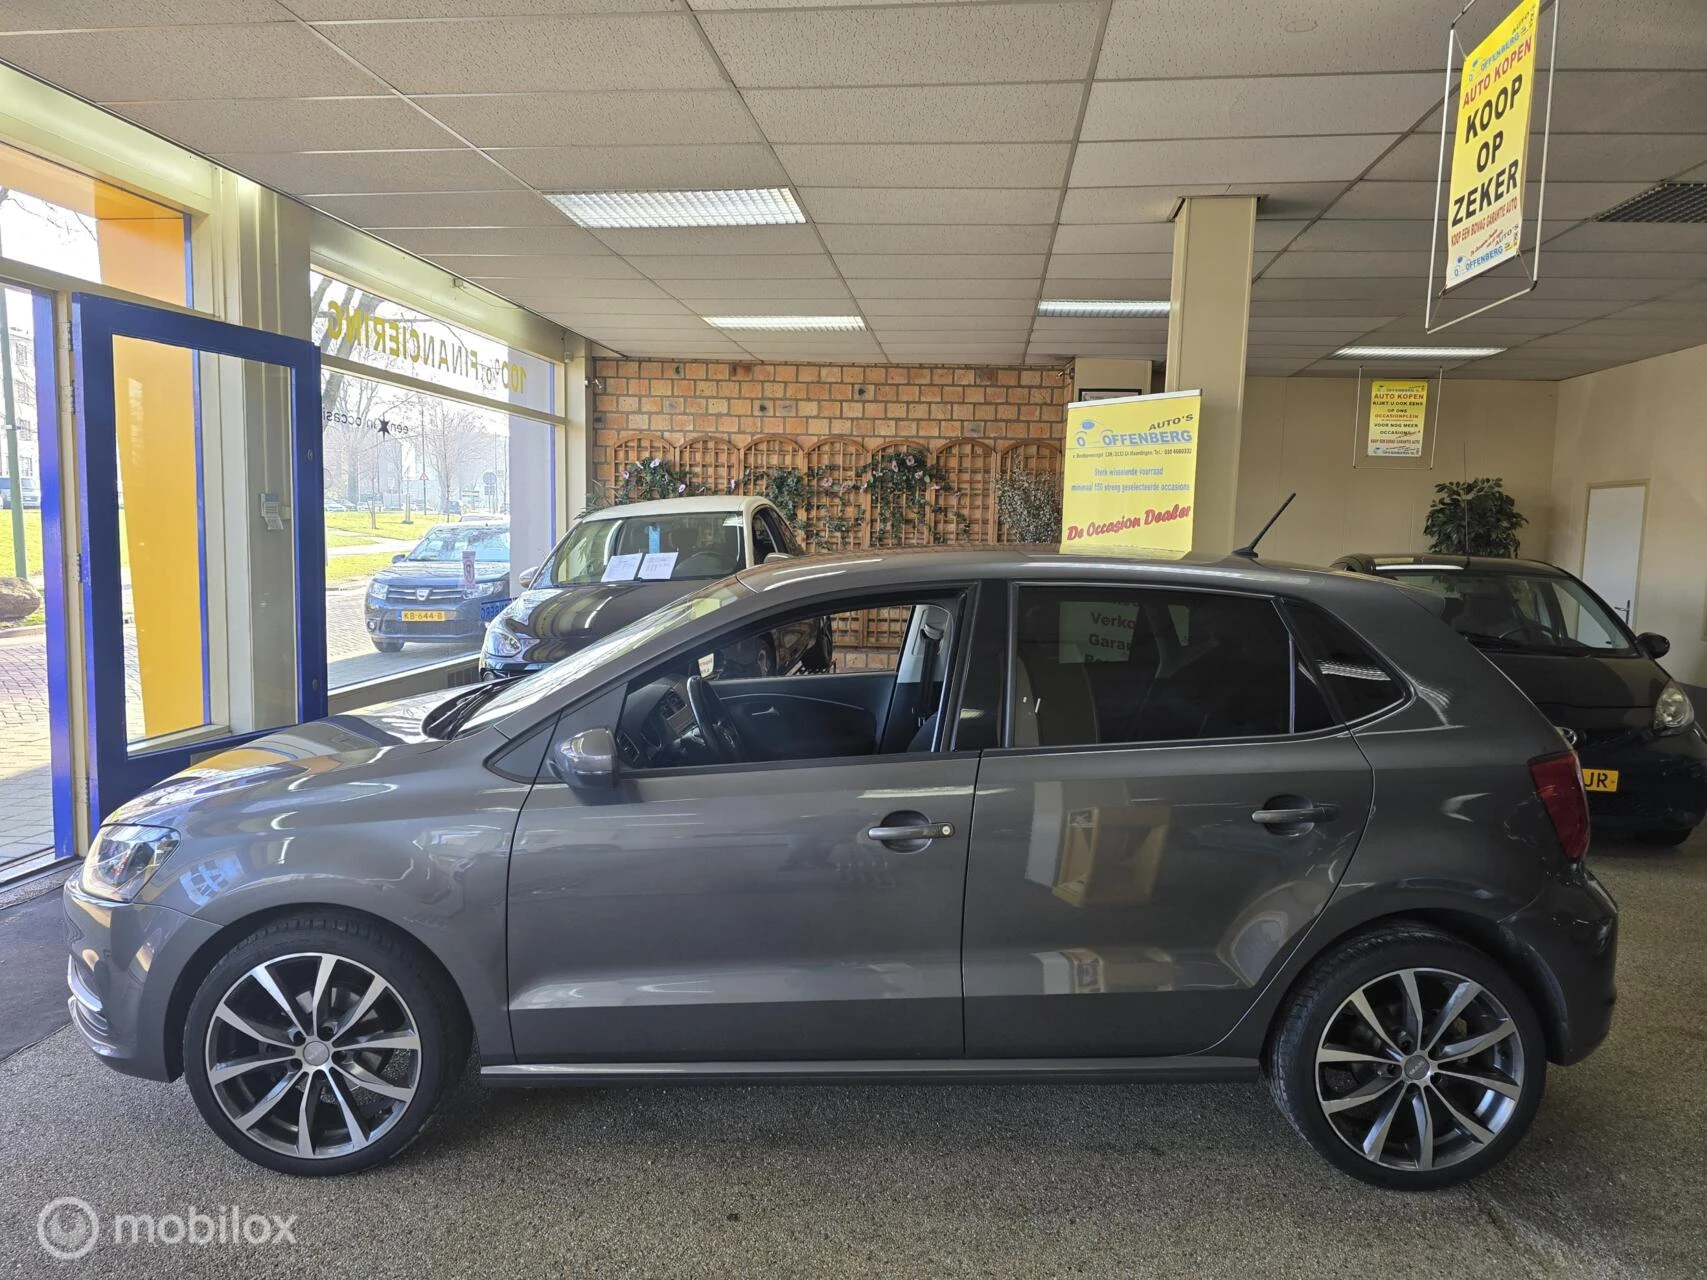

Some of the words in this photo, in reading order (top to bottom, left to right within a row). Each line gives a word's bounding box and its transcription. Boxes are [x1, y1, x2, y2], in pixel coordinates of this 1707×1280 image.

[1463, 73, 1491, 108] AUTO
[1494, 37, 1532, 82] KOPEN
[1465, 73, 1523, 145] KOOP
[1476, 130, 1504, 173] OP
[1451, 158, 1519, 228] ZEKER
[1465, 245, 1504, 272] OFFENBERG
[1102, 430, 1193, 446] OFFENBERG
[1148, 413, 1194, 431] AUTO'S
[1067, 525, 1084, 541] De
[1086, 515, 1141, 537] Occasion
[1143, 504, 1192, 526] Dealer
